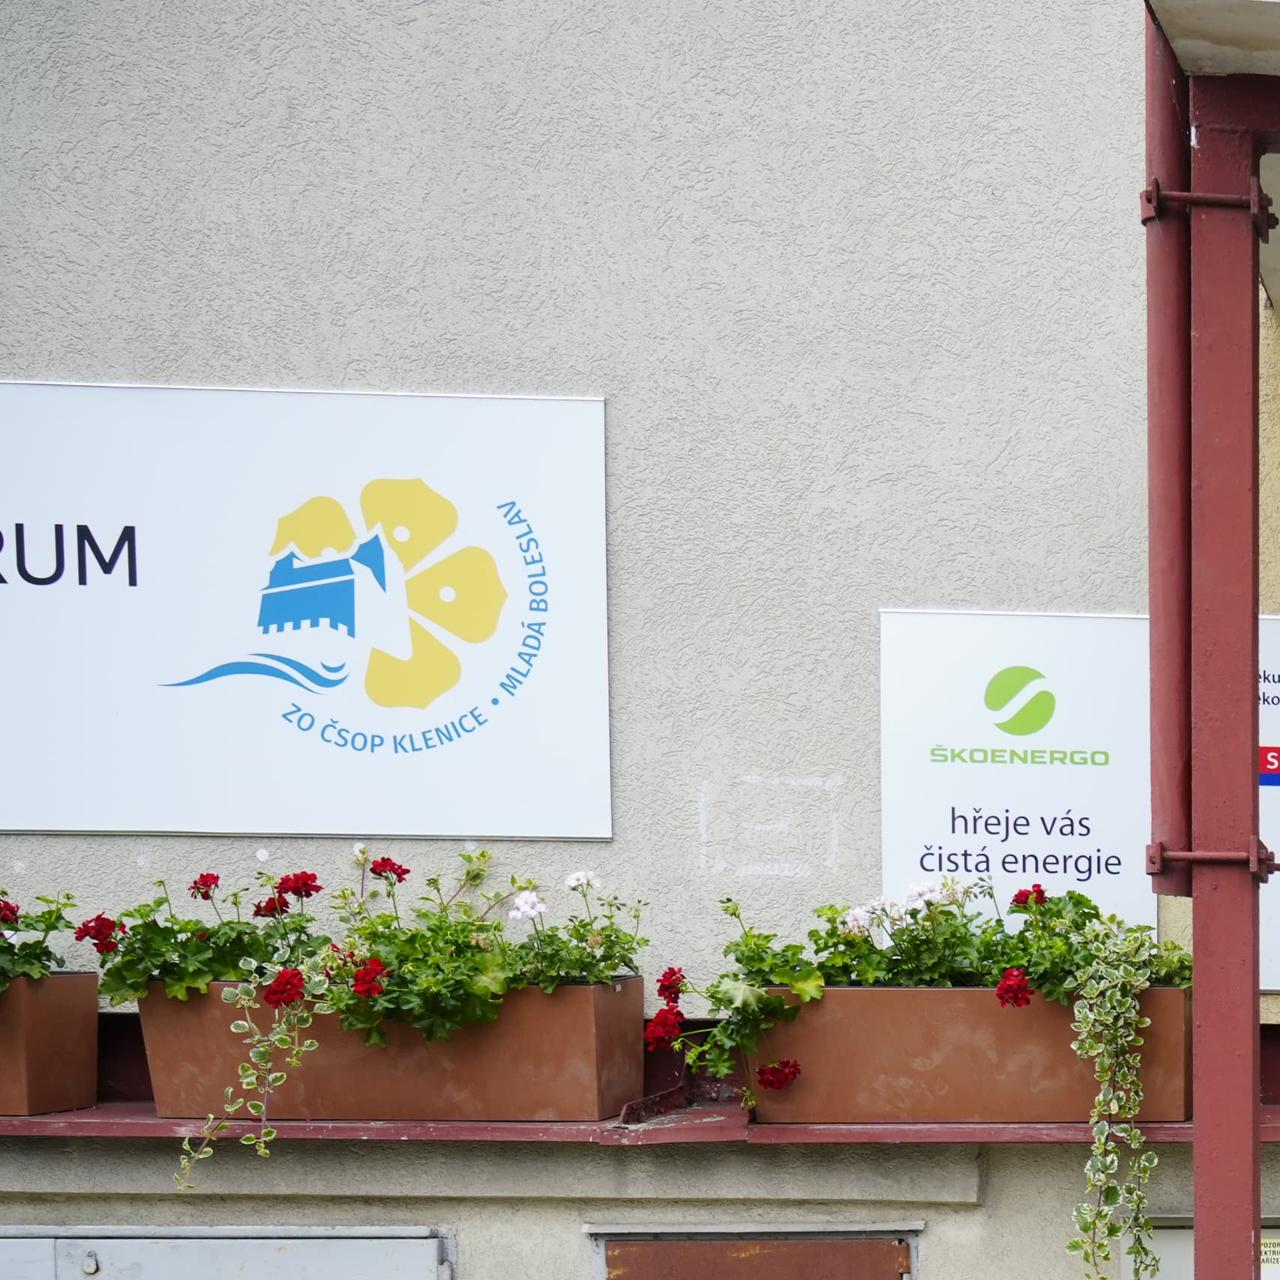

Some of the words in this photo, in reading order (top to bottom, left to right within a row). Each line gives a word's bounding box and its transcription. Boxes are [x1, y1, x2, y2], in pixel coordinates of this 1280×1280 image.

[496, 500, 550, 612] BOLESLAV
[500, 621, 546, 696] MLADÁ
[281, 702, 315, 732] ZO
[392, 706, 488, 754] KLENICE
[320, 718, 385, 754] ČSOP
[930, 743, 1110, 766] ŠKOENERGO
[950, 807, 1030, 843] hřeje
[1039, 808, 1090, 836] vás
[919, 847, 990, 874] čistá
[1001, 851, 1122, 882] energie
